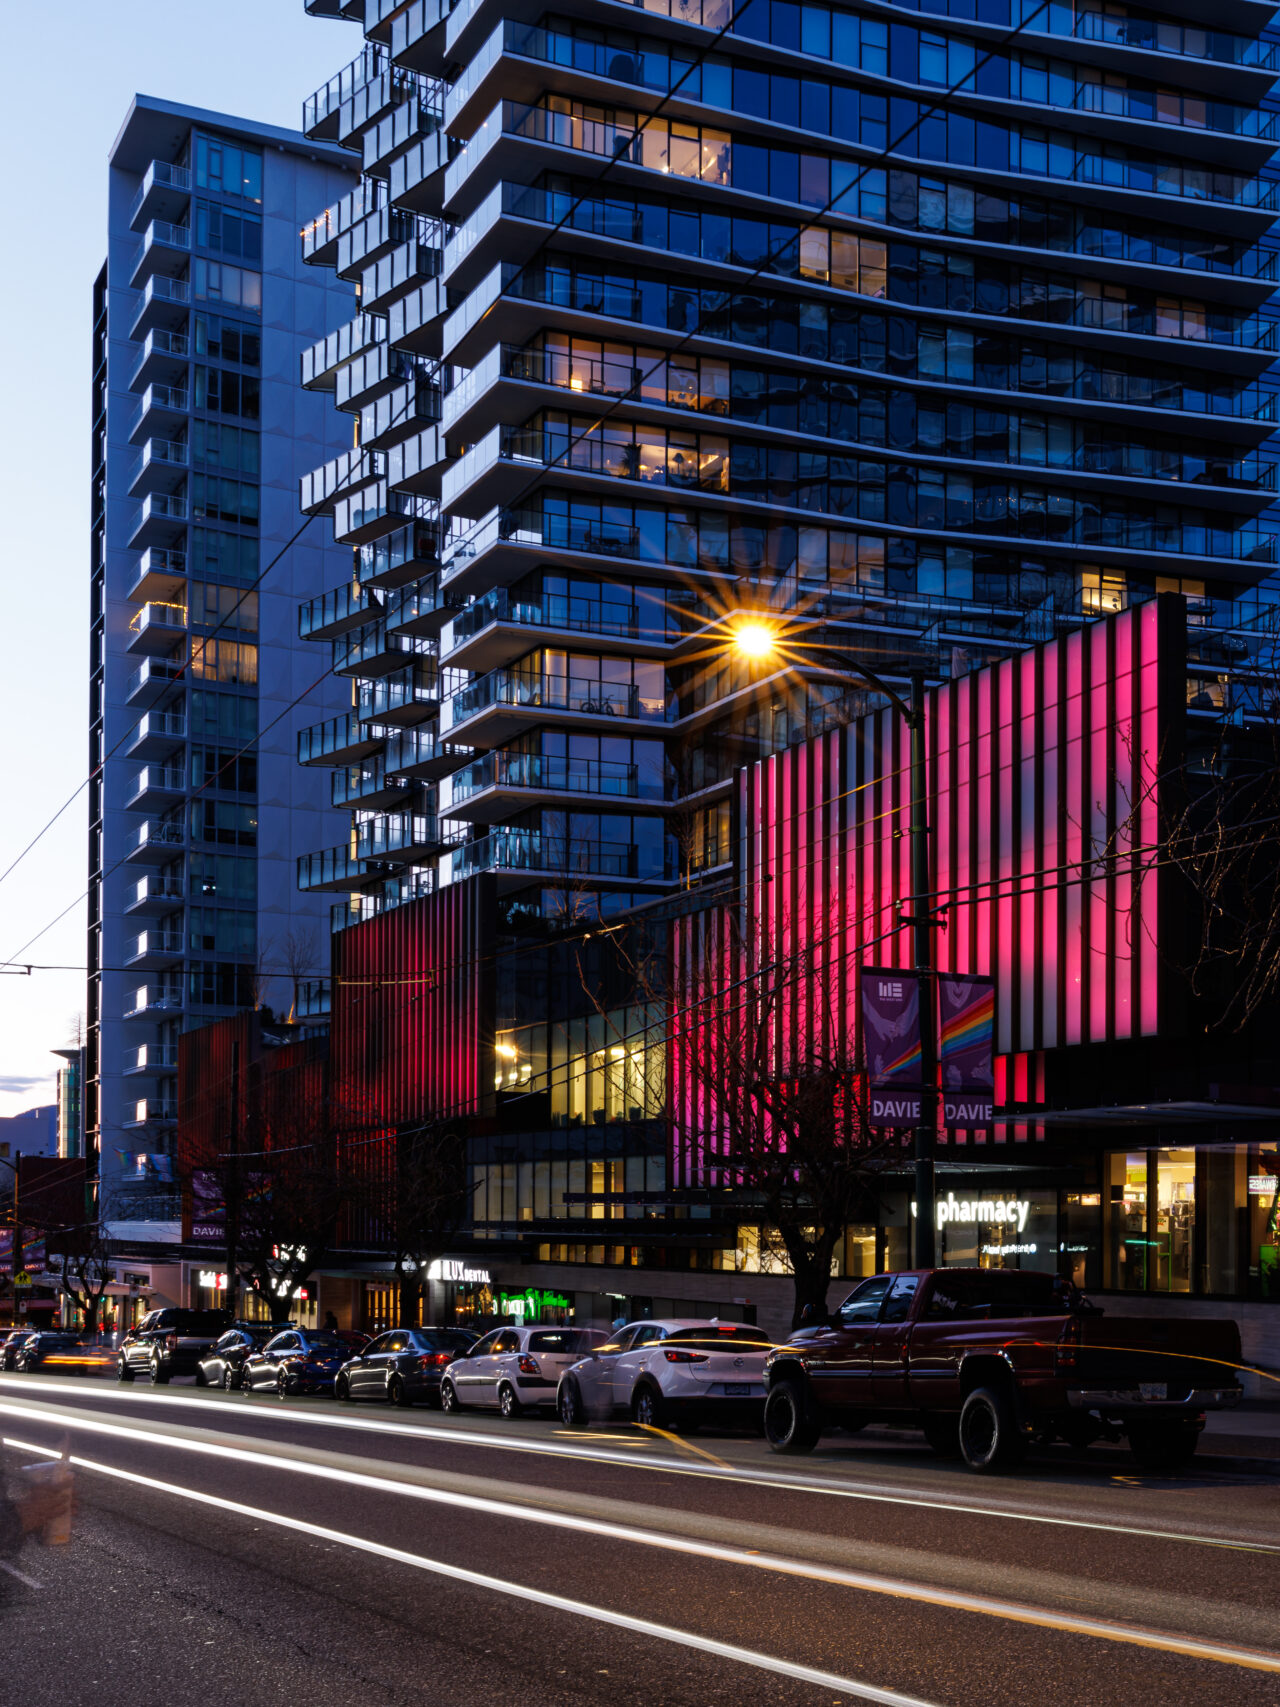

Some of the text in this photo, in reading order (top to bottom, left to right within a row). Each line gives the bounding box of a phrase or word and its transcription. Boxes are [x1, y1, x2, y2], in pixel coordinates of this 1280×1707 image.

[872, 1100, 920, 1118] DAVIE
[945, 1103, 993, 1121] DAVIE
[937, 1192, 1029, 1232] pharmacy
[464, 1268, 490, 1283] DENTAL
